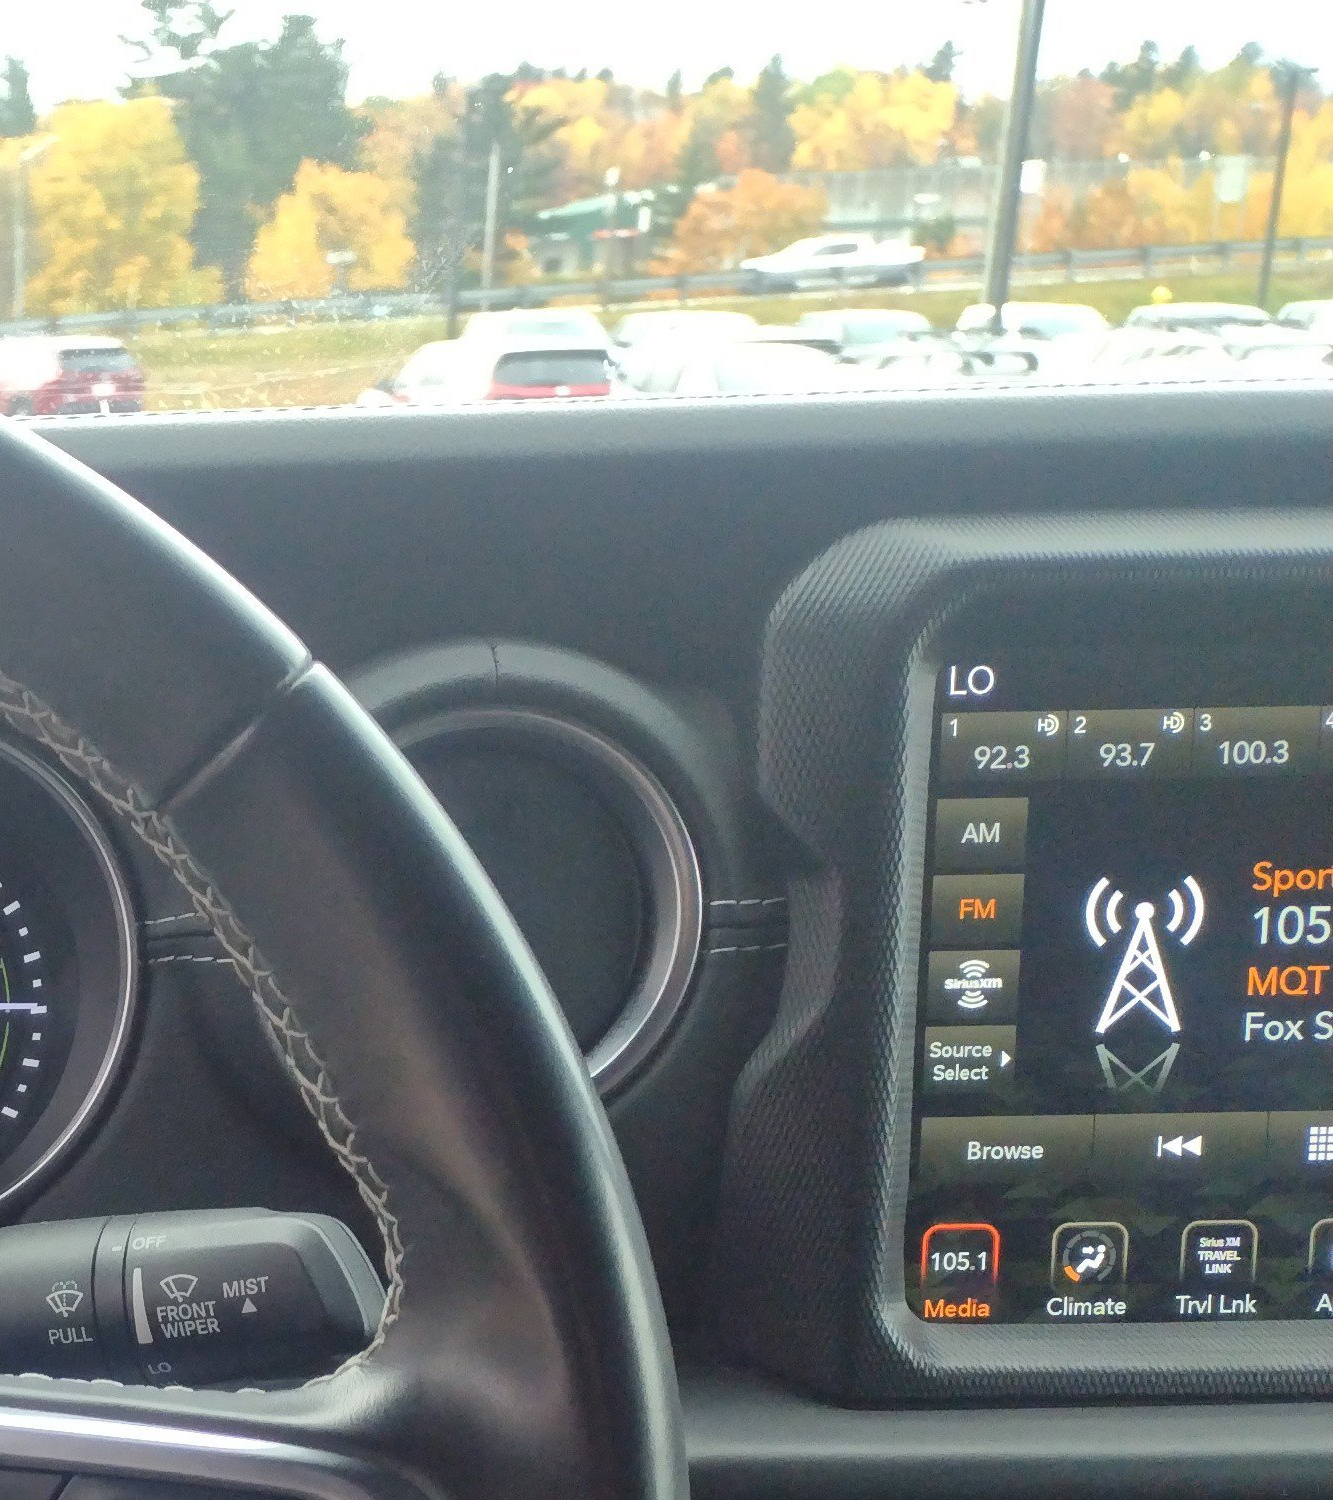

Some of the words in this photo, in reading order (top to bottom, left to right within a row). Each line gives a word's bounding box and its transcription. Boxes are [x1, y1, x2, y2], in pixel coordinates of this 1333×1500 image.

[949, 665, 995, 695] LO
[949, 718, 959, 737] 1
[1074, 716, 1087, 734] 2
[1199, 713, 1212, 731] 3
[974, 745, 1031, 770] 92.3
[1099, 742, 1156, 768] 93.7
[1219, 739, 1290, 766] 100.3
[961, 822, 1001, 843] AM
[959, 898, 997, 920] FM
[1247, 964, 1331, 997] MQT
[1244, 1011, 1304, 1042] Fox
[929, 1042, 993, 1059] Source
[932, 1064, 989, 1082] Select
[966, 1141, 1044, 1160] Browse
[131, 1234, 167, 1251] OFF
[930, 1250, 988, 1272] 105.1
[1197, 1250, 1242, 1261] TRAVEL
[1205, 1263, 1233, 1274] LINK
[222, 1275, 269, 1299] MIST
[156, 1300, 217, 1323] FRONT
[923, 1299, 991, 1318] Media
[1046, 1296, 1127, 1317] Climate
[1175, 1293, 1212, 1314] Trvl
[1219, 1293, 1258, 1314] Lnk
[48, 1325, 94, 1345] PULL
[160, 1317, 221, 1339] WIPER
[147, 1361, 172, 1375] LO
